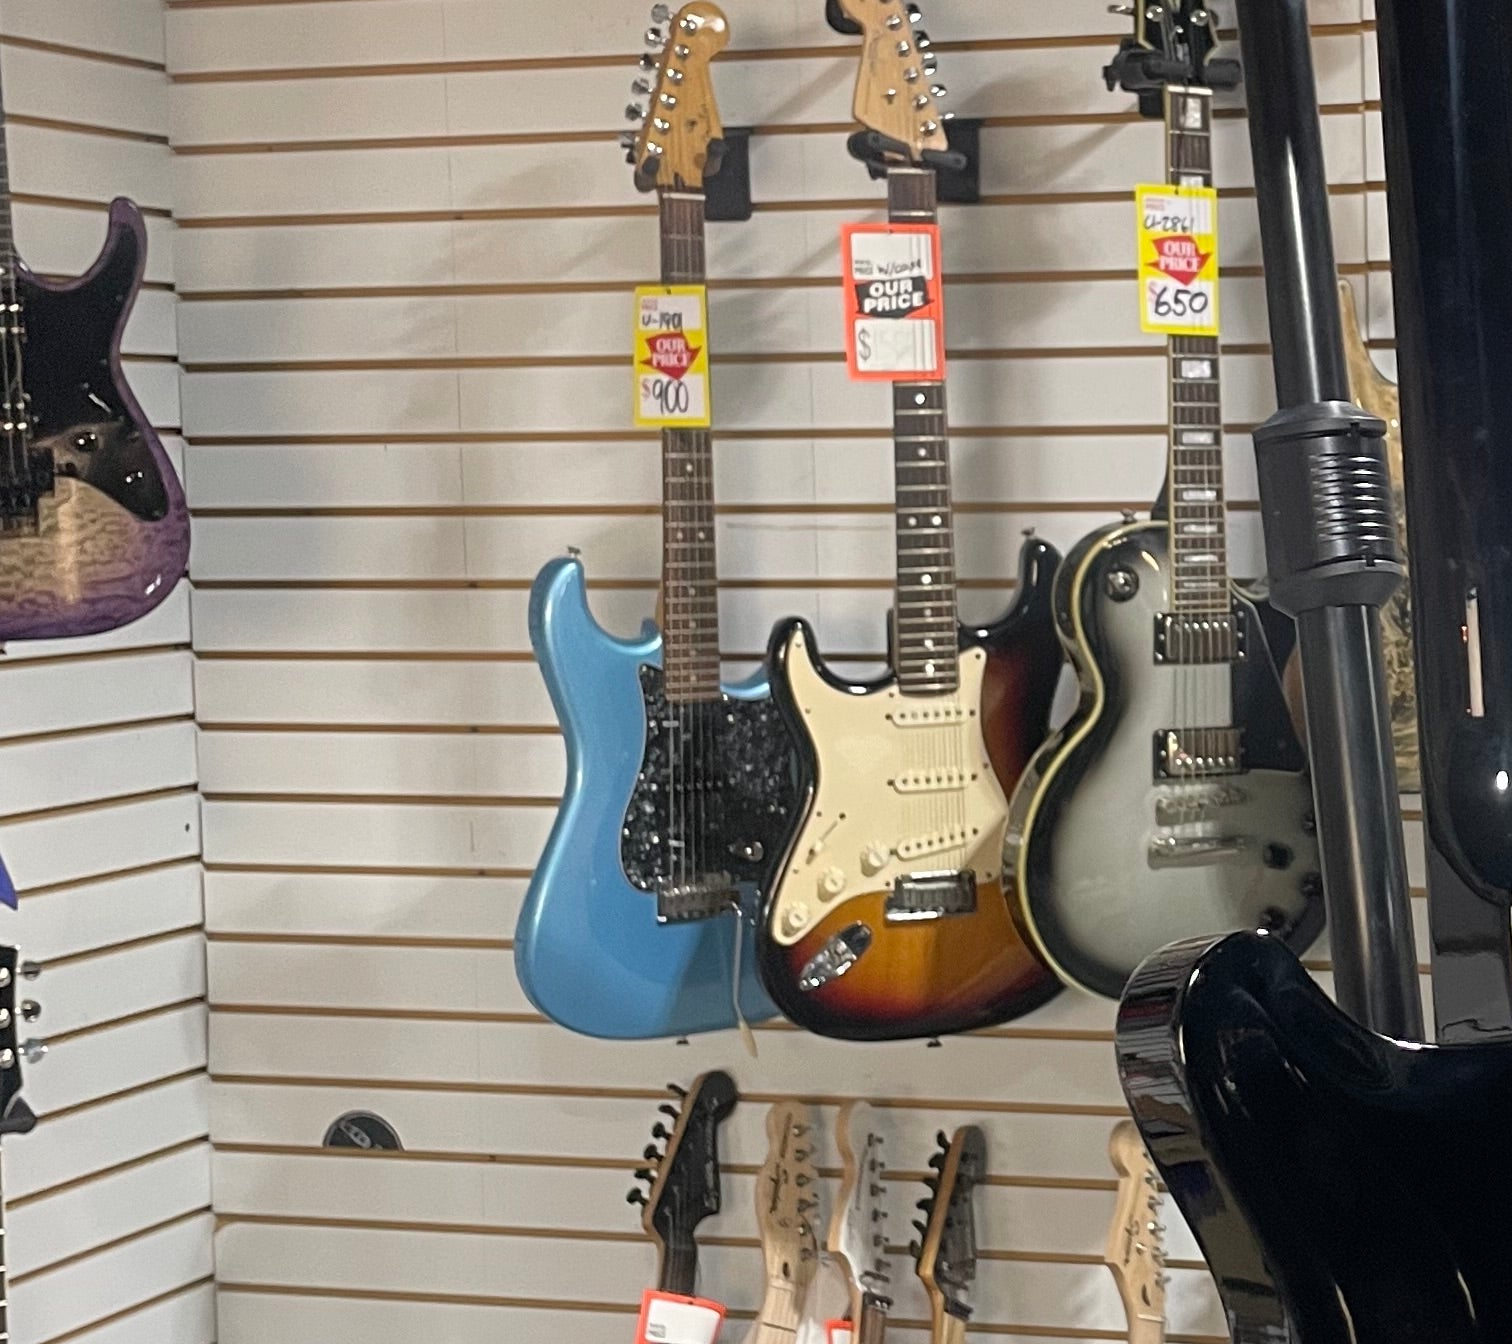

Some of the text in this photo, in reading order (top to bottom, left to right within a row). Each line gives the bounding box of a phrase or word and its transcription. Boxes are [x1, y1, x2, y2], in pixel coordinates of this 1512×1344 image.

[1163, 240, 1196, 257] OUR
[1159, 256, 1202, 272] PRICE
[869, 279, 913, 297] OUR
[863, 291, 924, 313] PRICE
[656, 338, 687, 354] OUR
